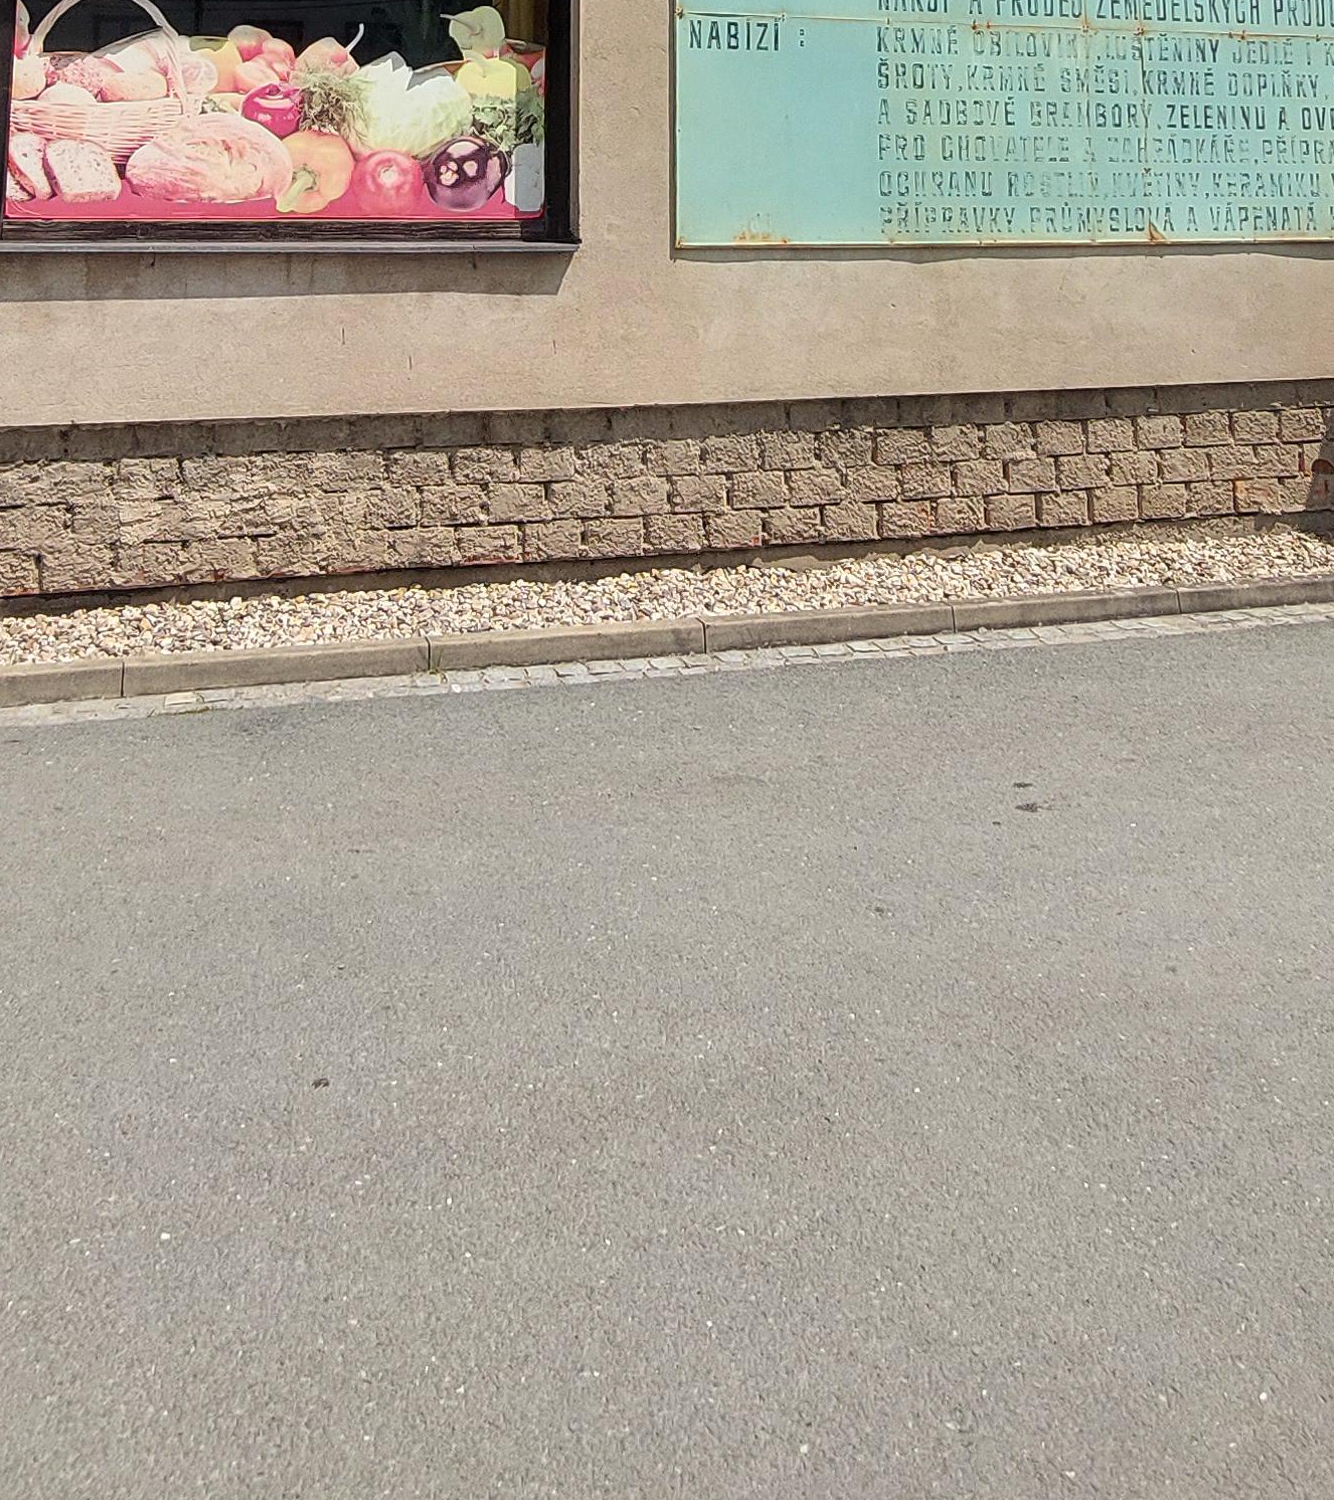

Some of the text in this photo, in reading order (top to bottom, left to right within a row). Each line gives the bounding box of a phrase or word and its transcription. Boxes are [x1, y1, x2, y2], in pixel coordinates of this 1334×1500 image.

[876, 25, 958, 55] KRMNÉ
[878, 99, 891, 125] A
[1278, 106, 1291, 132] A
[878, 133, 926, 161] PRO
[1186, 205, 1199, 232] A
